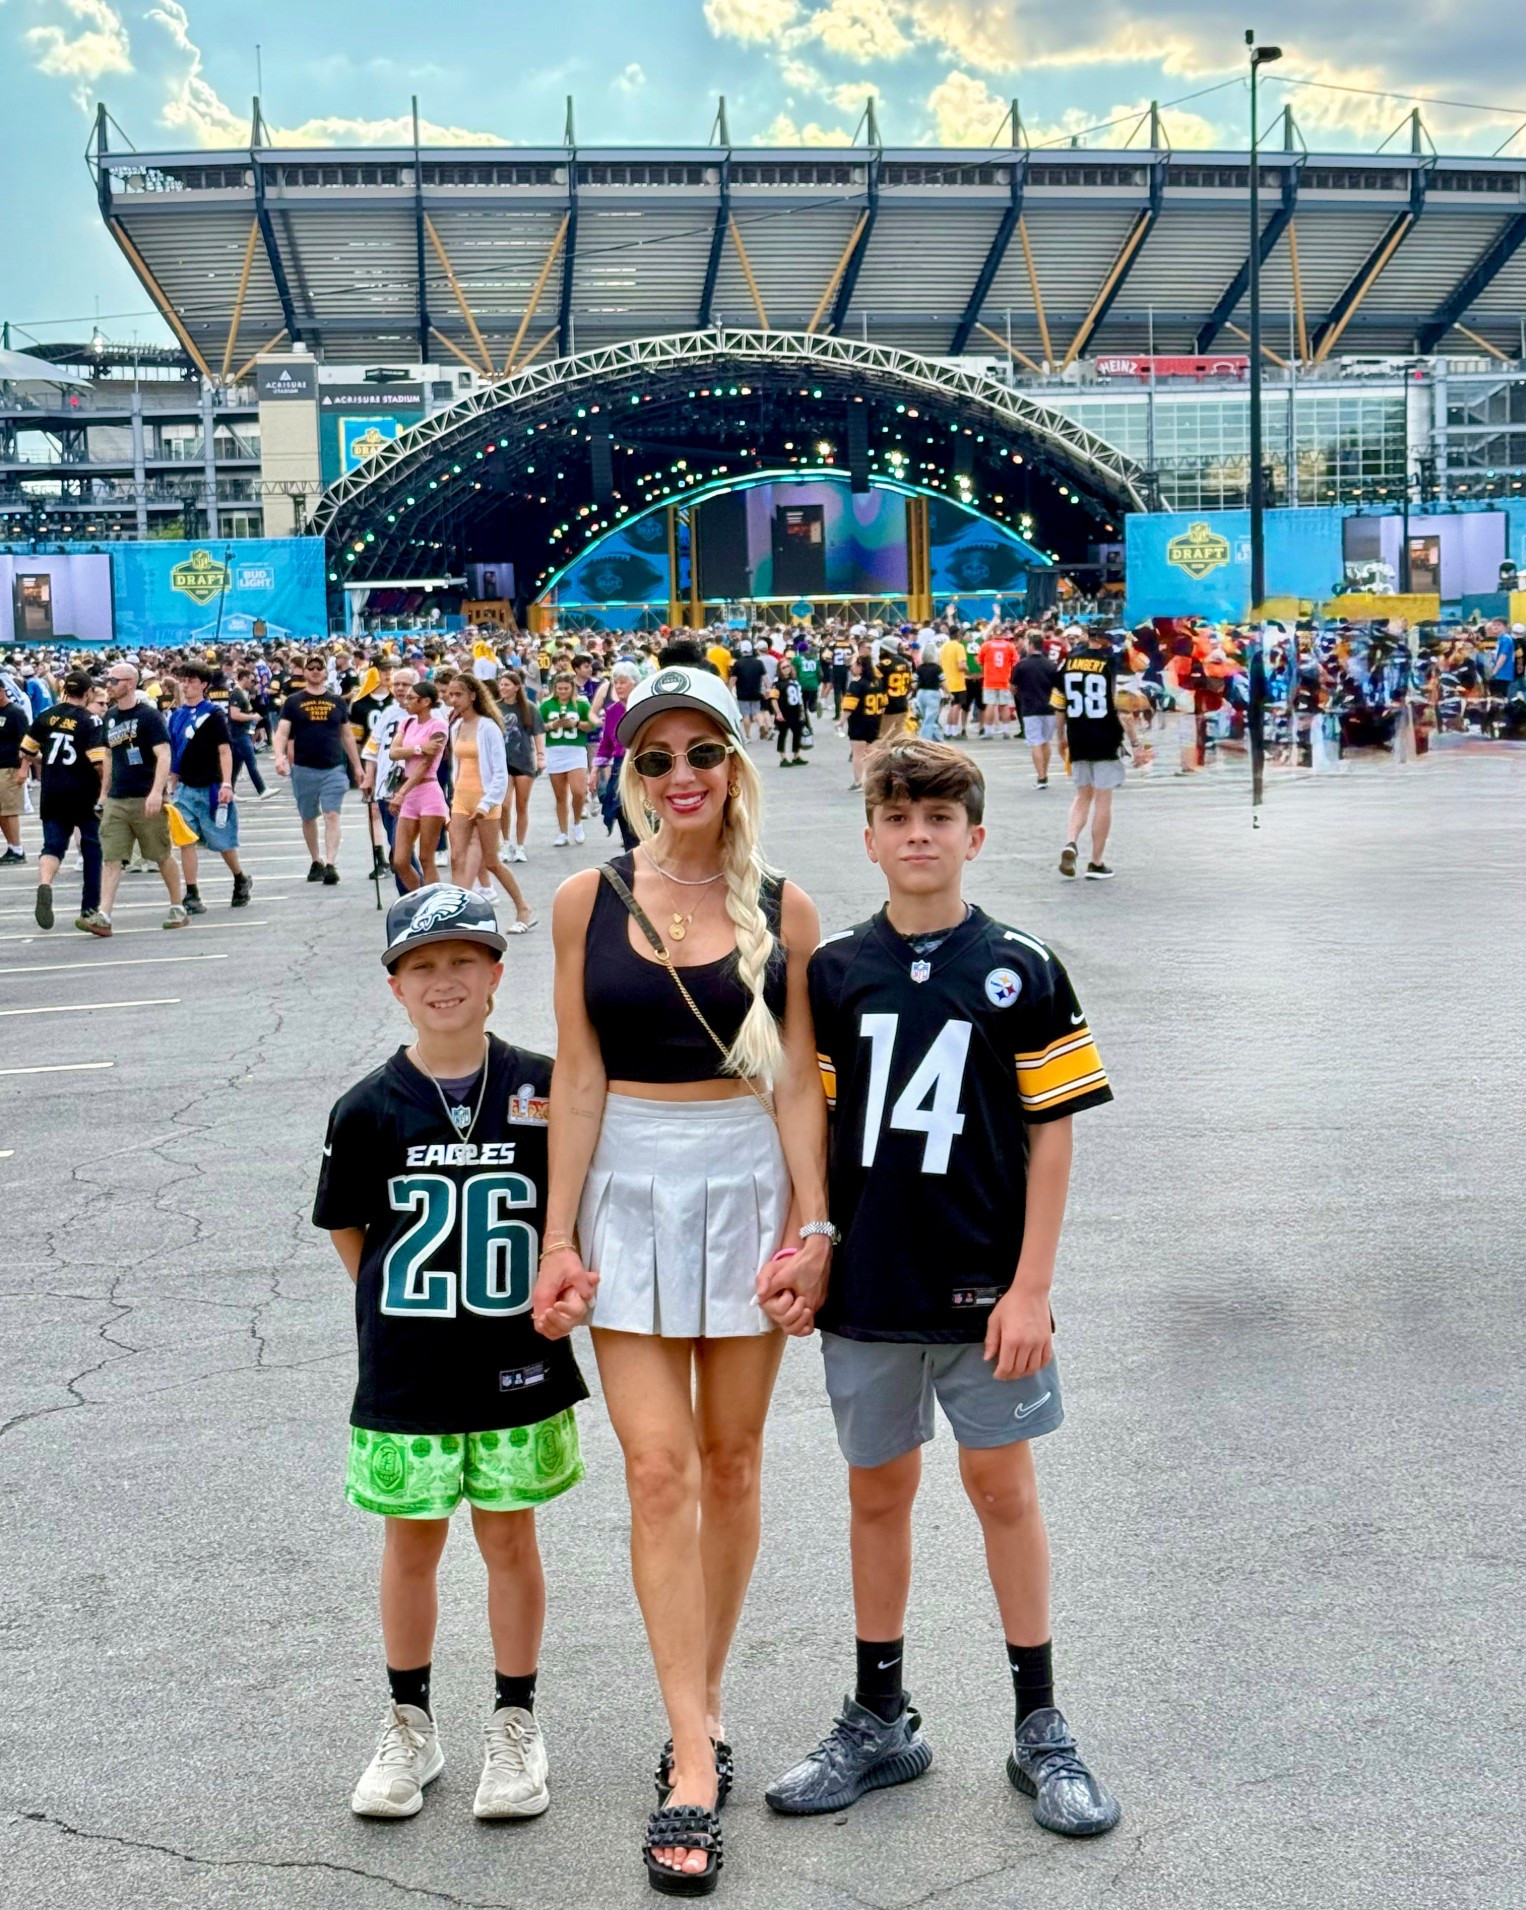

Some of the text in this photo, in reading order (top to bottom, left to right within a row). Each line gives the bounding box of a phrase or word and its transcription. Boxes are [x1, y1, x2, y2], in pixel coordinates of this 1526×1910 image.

[1099, 360, 1138, 375] HEINZ
[265, 381, 307, 389] ACRISURE
[333, 395, 420, 404] ACRISURE STADIUM
[1172, 548, 1224, 560] DRAFT
[176, 574, 226, 586] DRAFT
[243, 570, 266, 579] BUD
[239, 578, 272, 588] LIGHT
[1067, 658, 1107, 673] LAMBERT
[1064, 672, 1108, 719] 58
[46, 731, 78, 766] 75
[860, 1013, 973, 1174] 14
[380, 1171, 539, 1318] 26
